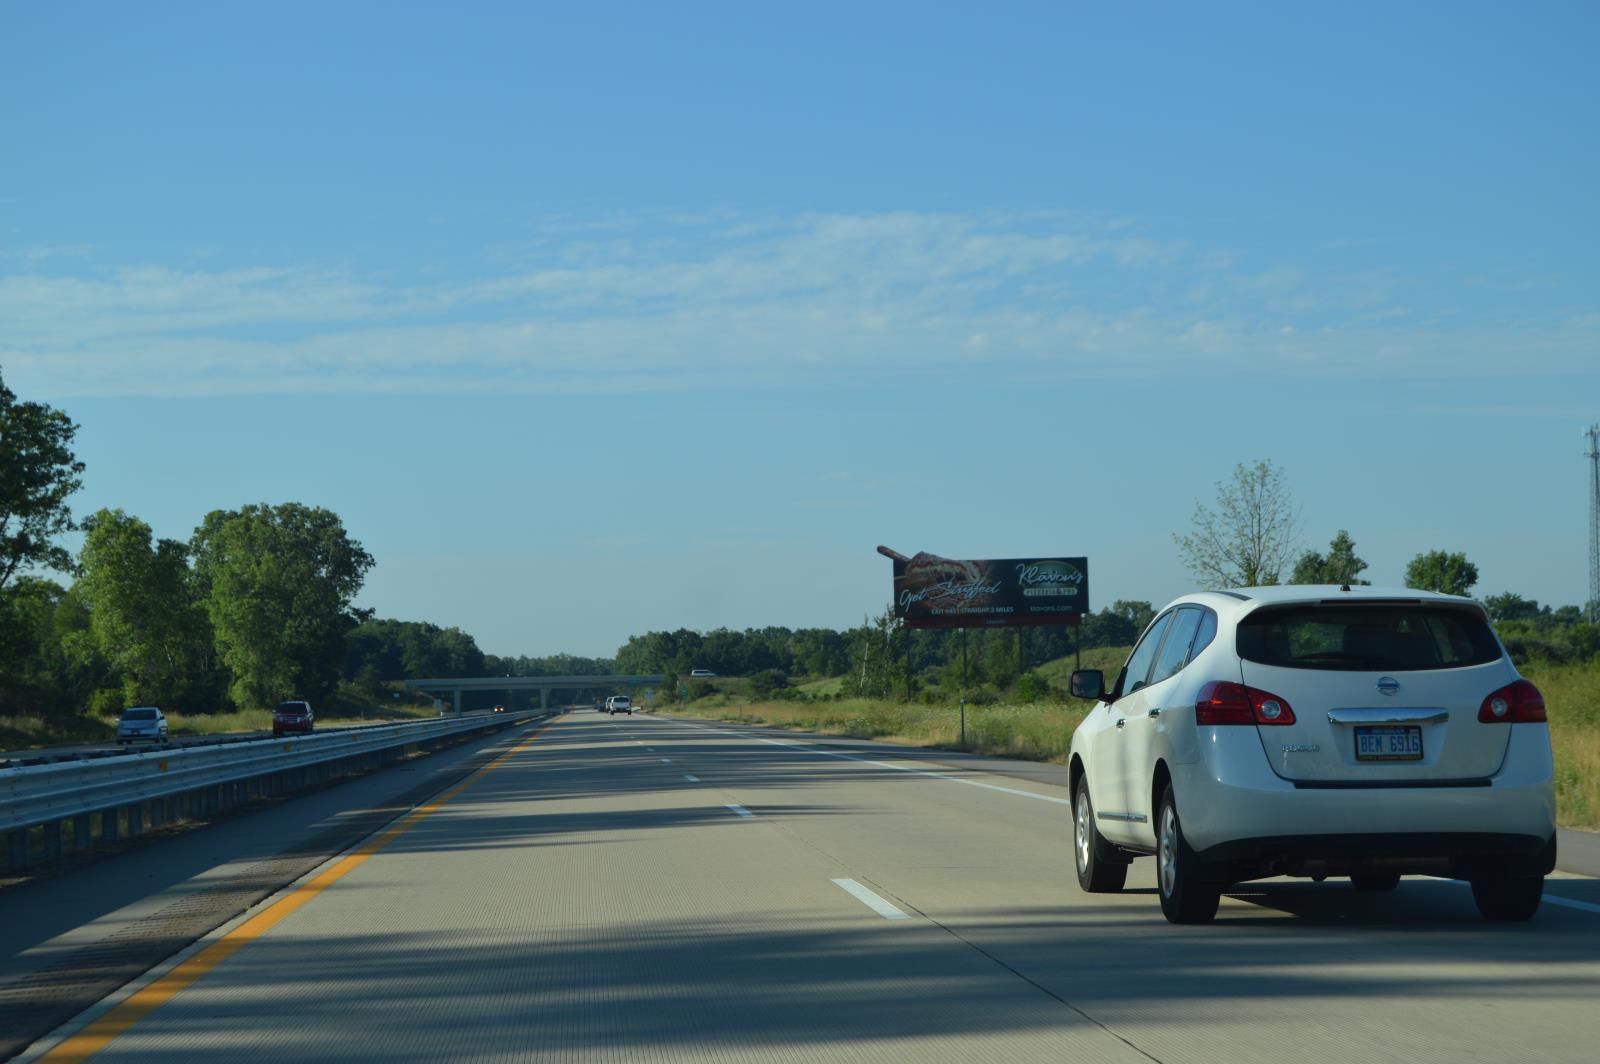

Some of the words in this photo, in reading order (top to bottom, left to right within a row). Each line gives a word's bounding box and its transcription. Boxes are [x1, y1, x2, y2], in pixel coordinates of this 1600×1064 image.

[899, 588, 927, 613] Get
[929, 577, 1002, 600] Stuffed
[1360, 735, 1383, 752] BEM
[1390, 735, 1419, 752] 6916
